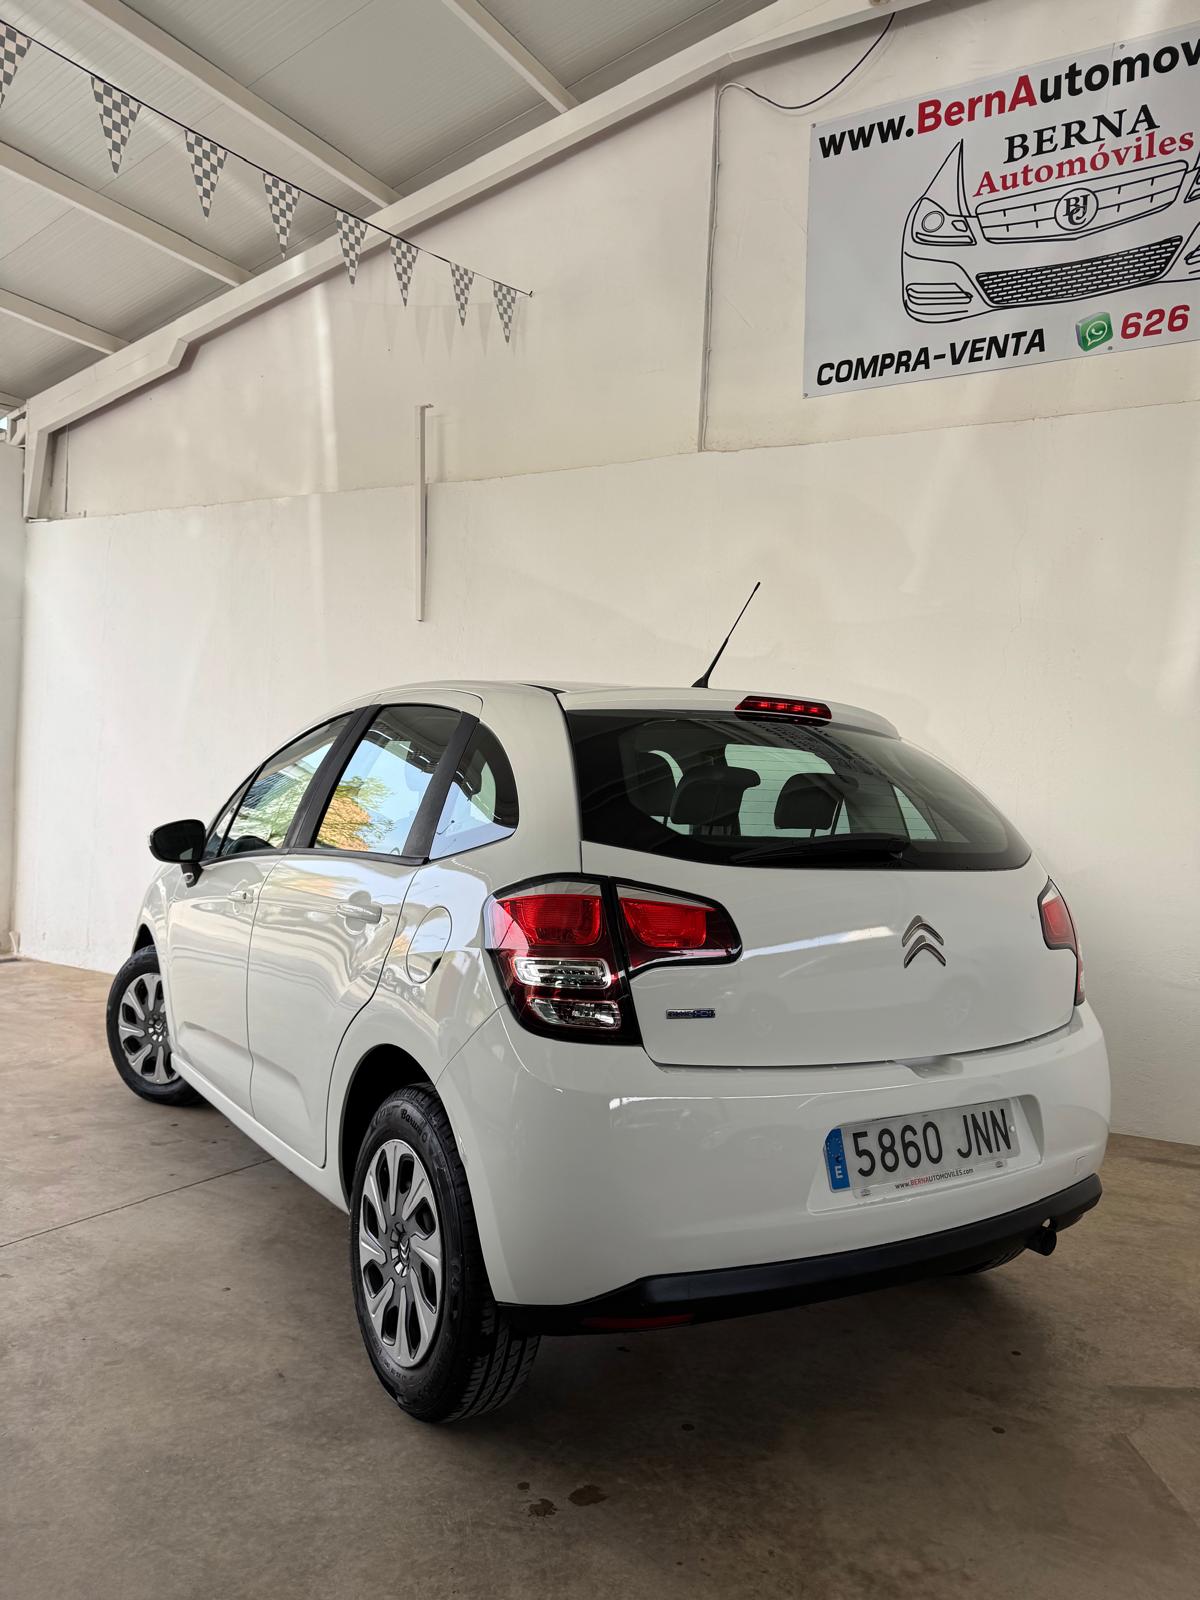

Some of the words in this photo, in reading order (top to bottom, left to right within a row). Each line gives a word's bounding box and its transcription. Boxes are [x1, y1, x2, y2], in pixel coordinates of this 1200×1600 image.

[1003, 104, 1160, 164] BERNA
[972, 131, 1194, 197] Automóviles
[1120, 304, 1190, 340] 626
[816, 328, 1046, 386] COMPRA-VENTA
[834, 1165, 843, 1179] E
[852, 1121, 943, 1177] 5860
[957, 1108, 1012, 1158] JNN
